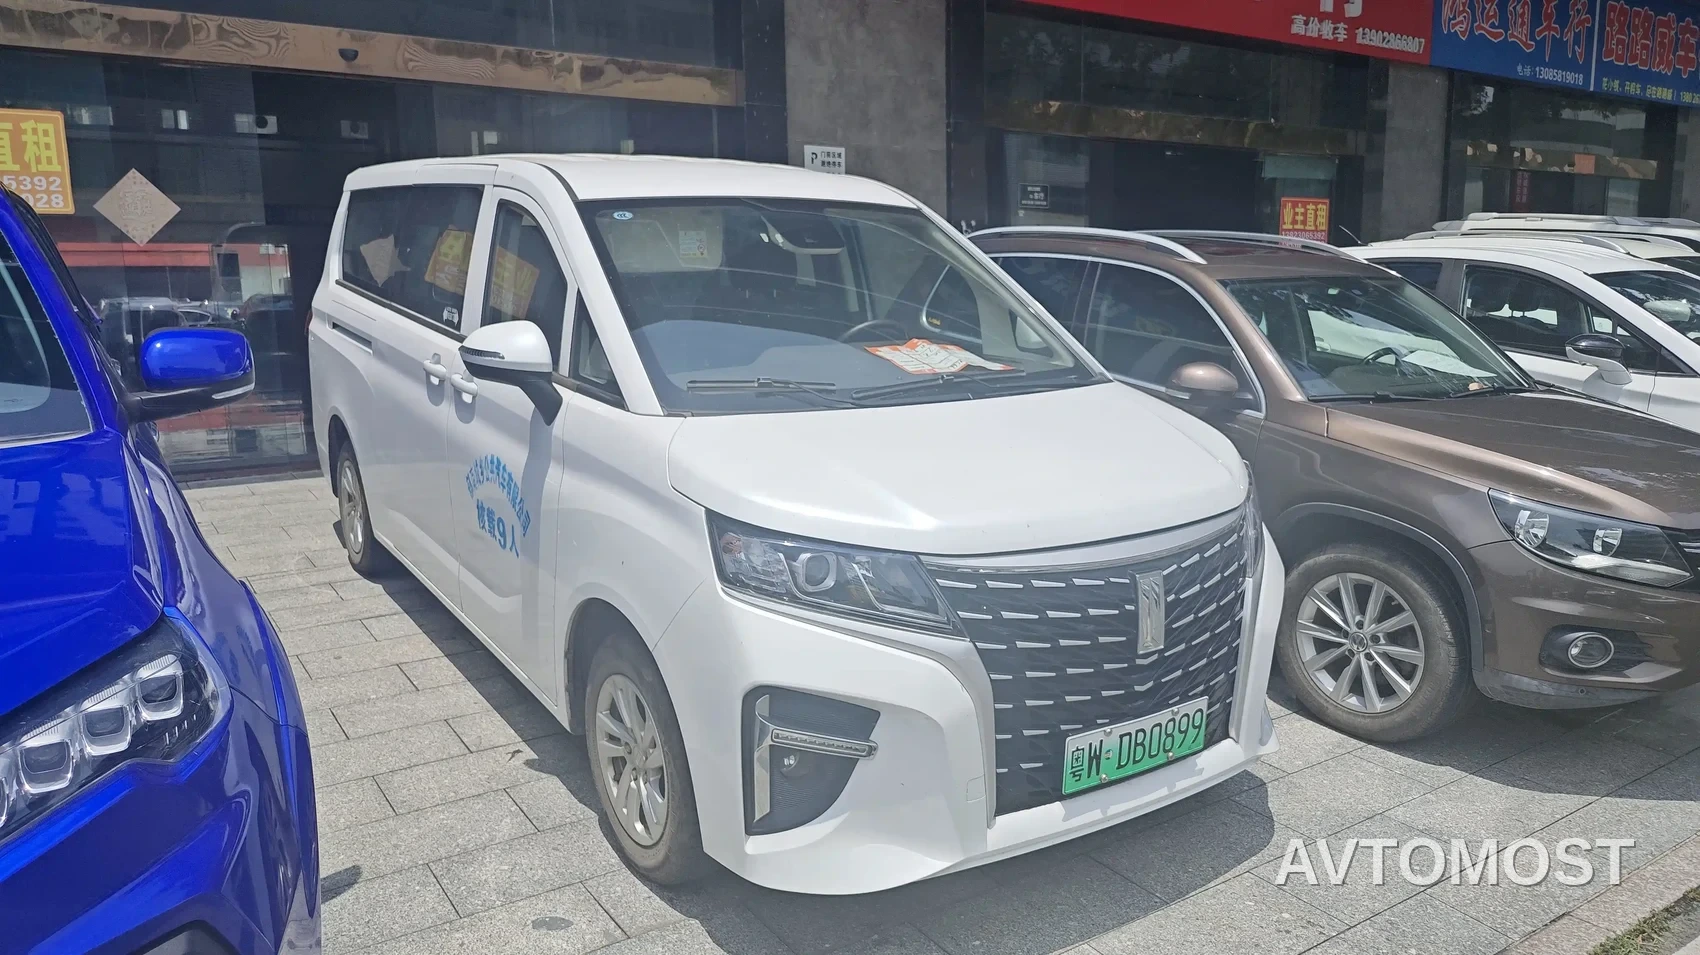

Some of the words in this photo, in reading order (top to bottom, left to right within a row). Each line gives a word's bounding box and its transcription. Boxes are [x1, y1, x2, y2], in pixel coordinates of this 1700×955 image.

[1290, 14, 1348, 42] 高价收车
[1355, 27, 1425, 54] 13902866807
[1282, 202, 1326, 231] 业主直租
[476, 498, 519, 559] 核载9人
